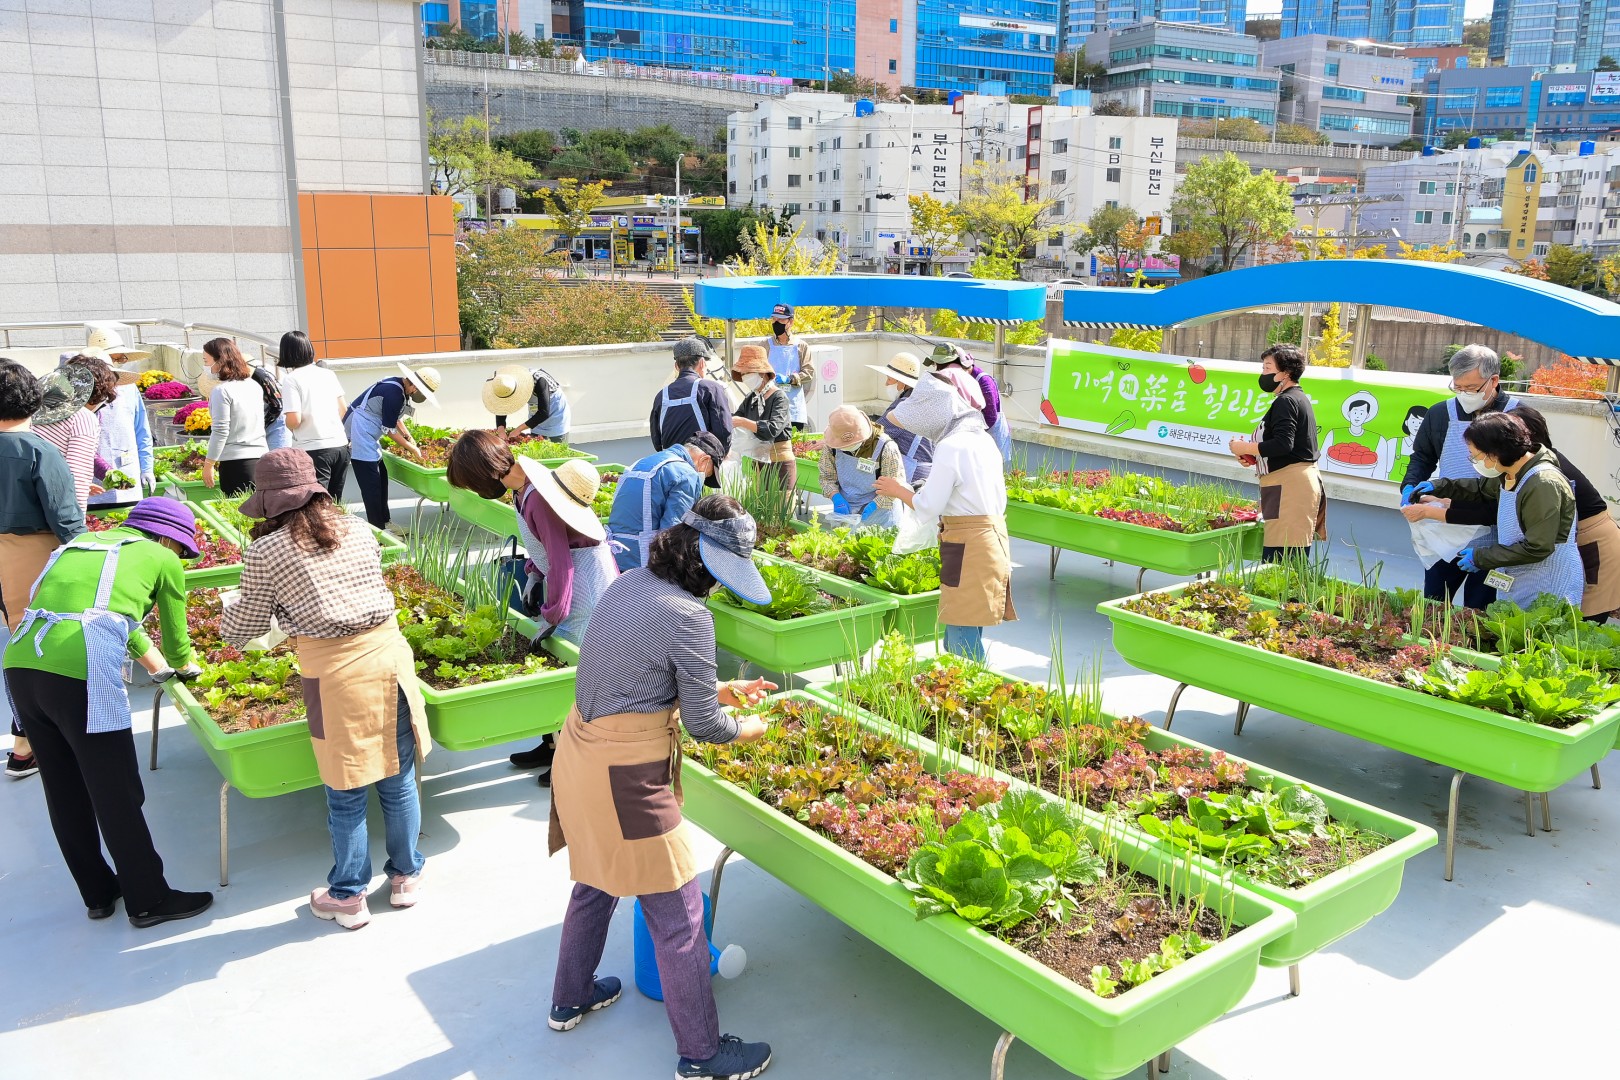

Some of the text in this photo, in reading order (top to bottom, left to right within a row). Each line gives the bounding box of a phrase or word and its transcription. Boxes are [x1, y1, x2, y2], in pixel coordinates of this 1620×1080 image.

[911, 143, 922, 156] A
[1109, 153, 1120, 165] B
[702, 197, 717, 205] Self
[823, 383, 837, 394] LG
[1169, 428, 1221, 445] 해운대구보건소
